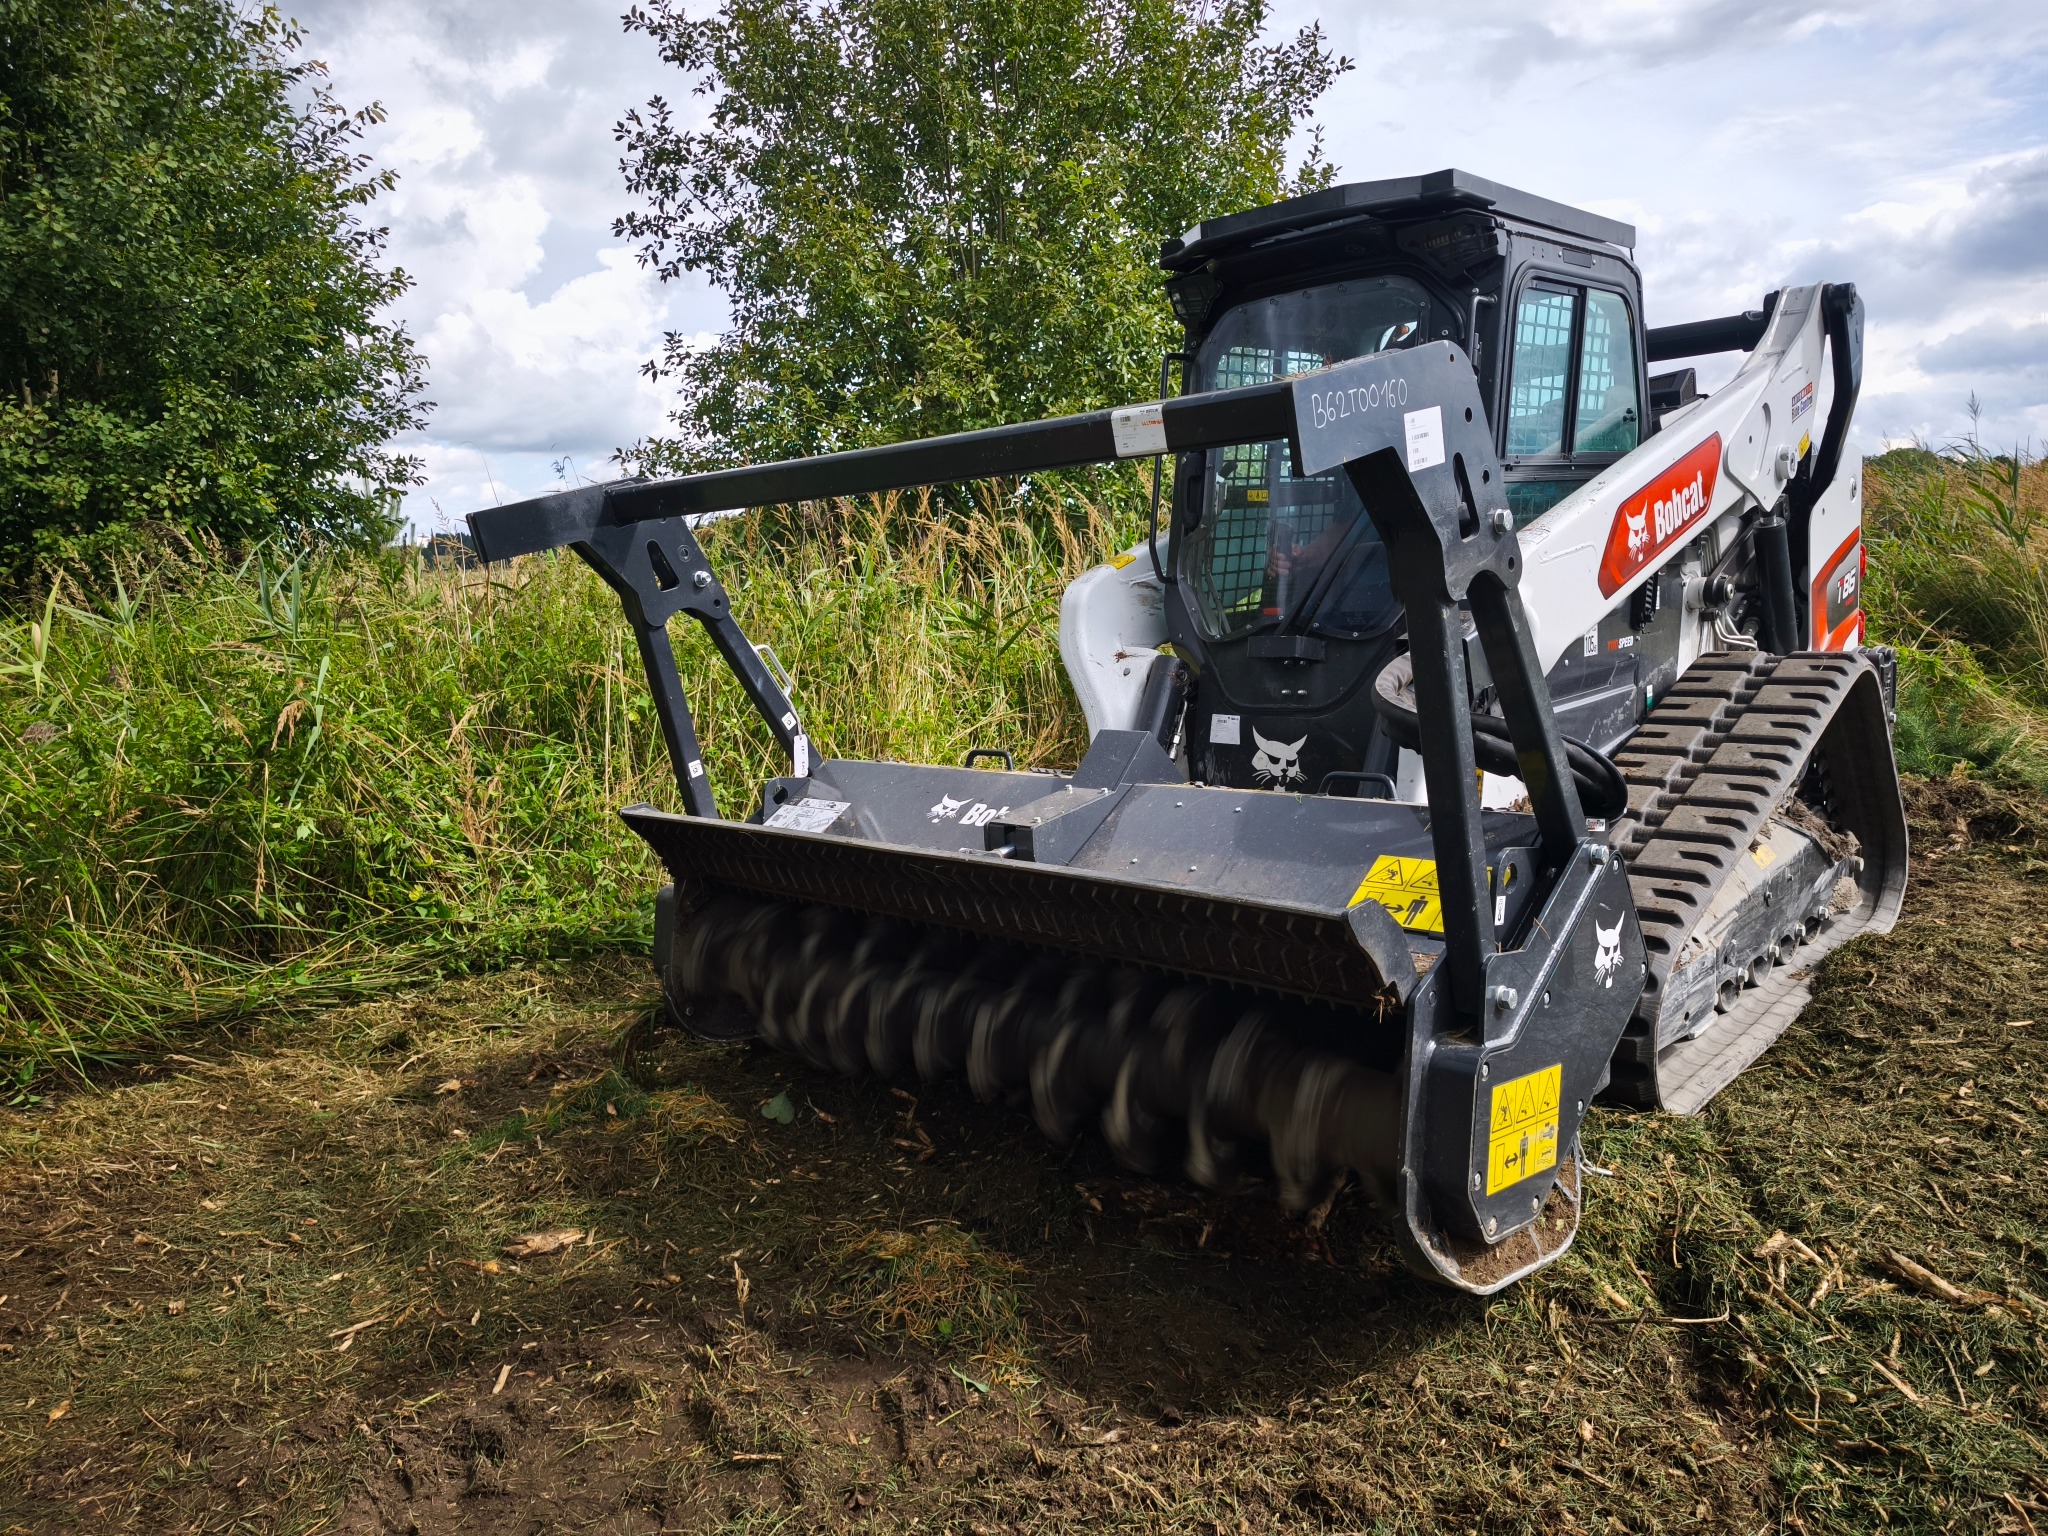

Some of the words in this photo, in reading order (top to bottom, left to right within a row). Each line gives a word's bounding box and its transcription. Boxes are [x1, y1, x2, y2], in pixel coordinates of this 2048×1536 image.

[1311, 378, 1408, 429] B62T00160
[1653, 470, 1704, 545] Bobcat
[1618, 635, 1634, 649] SPEED
